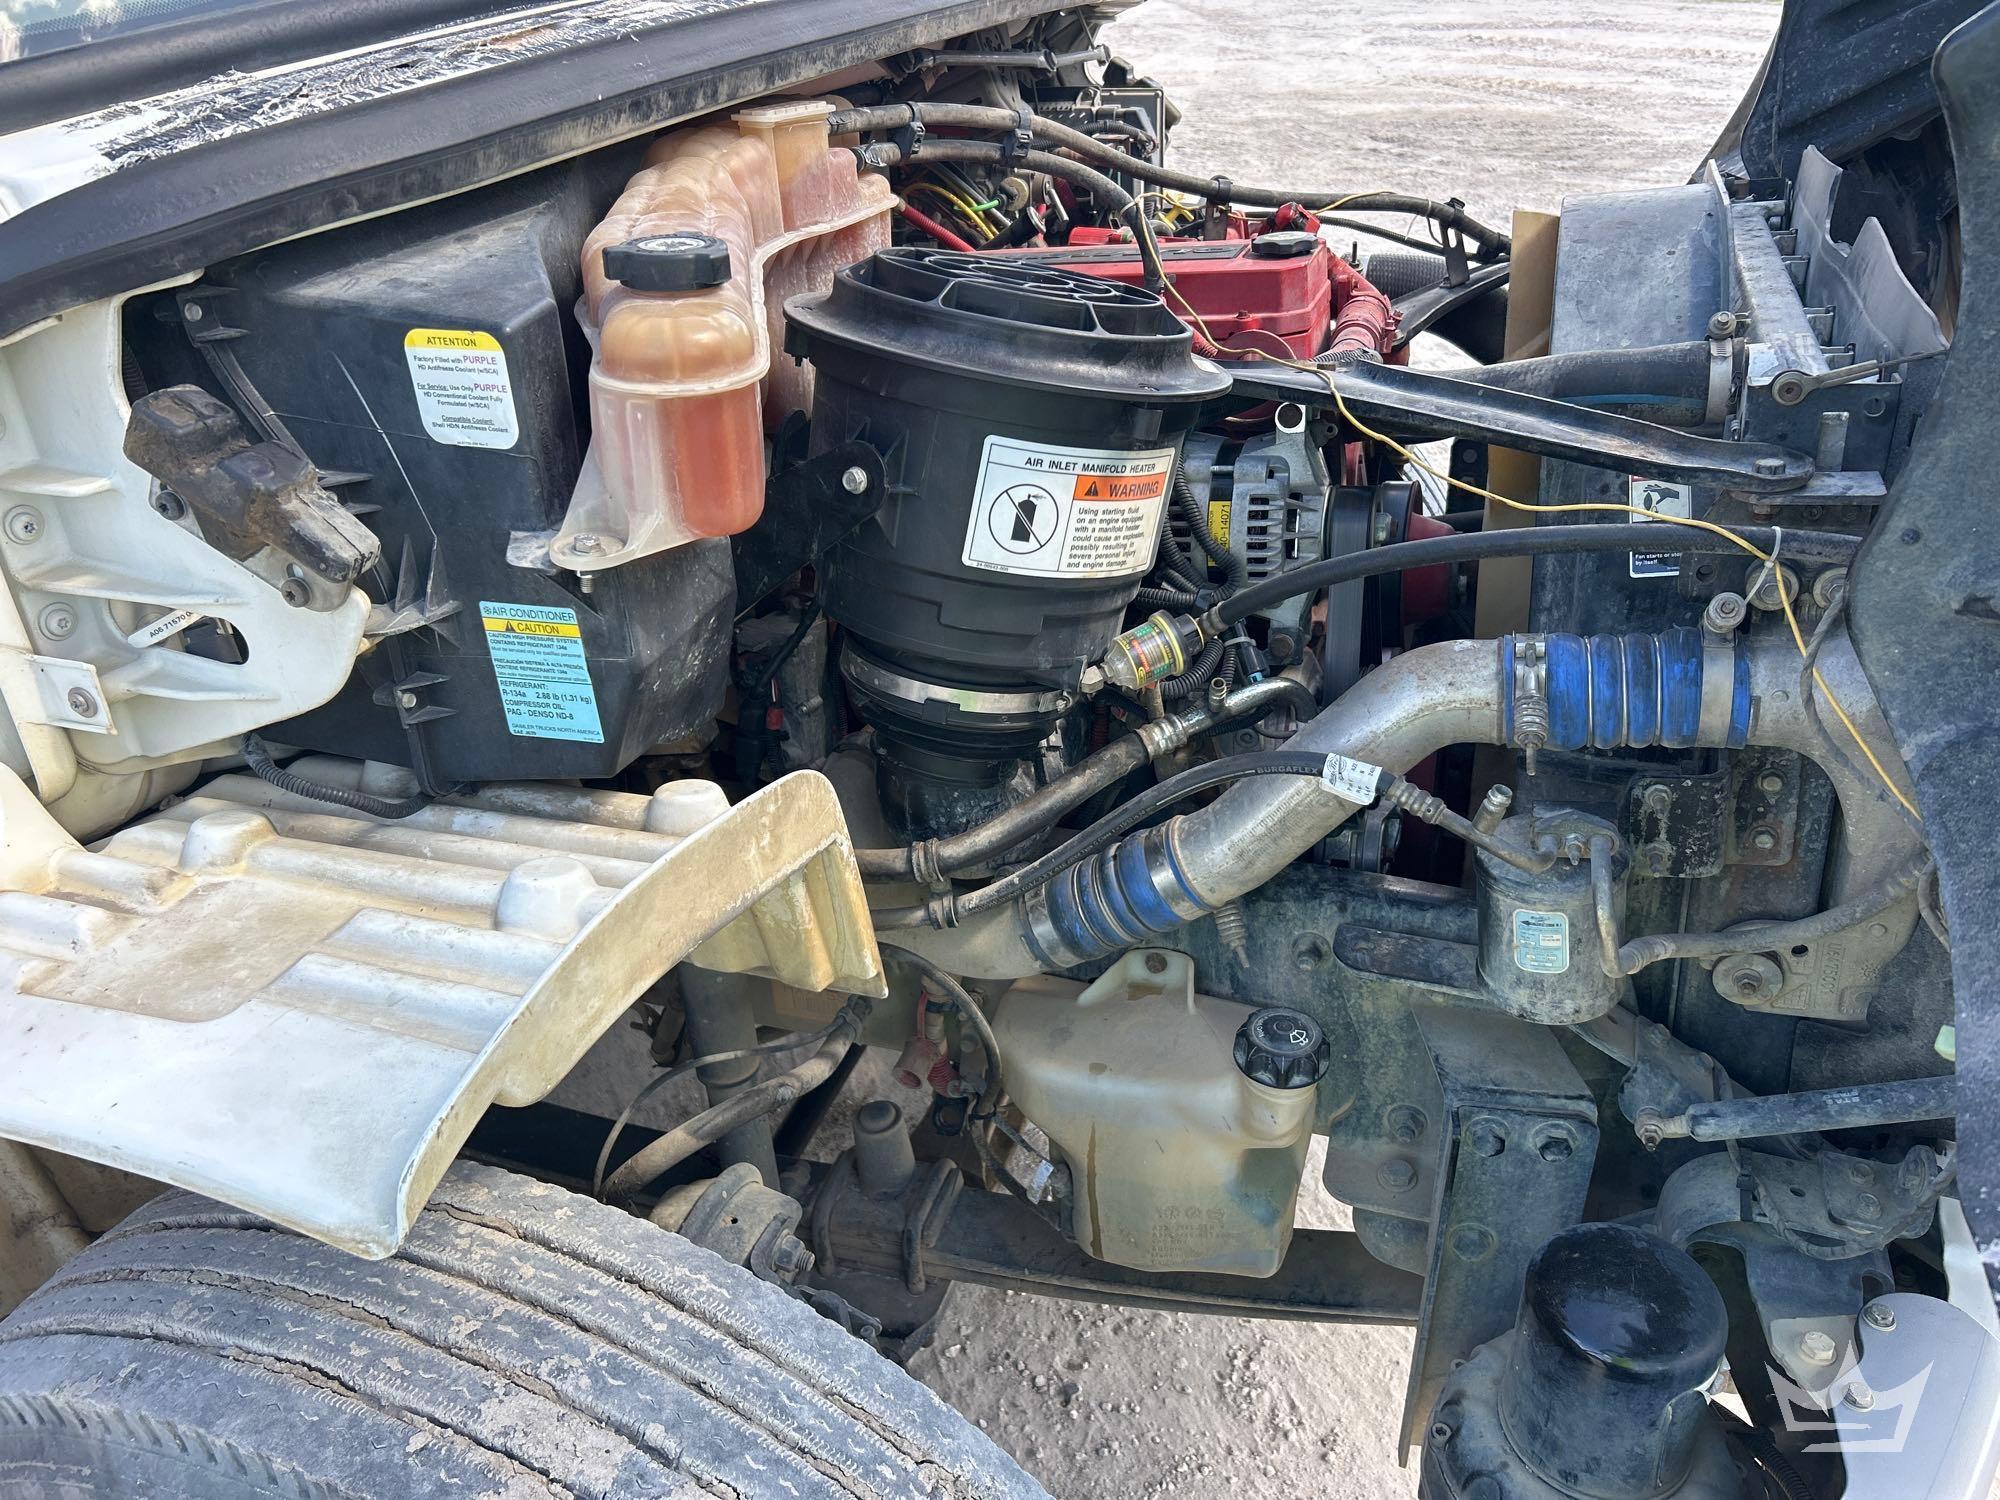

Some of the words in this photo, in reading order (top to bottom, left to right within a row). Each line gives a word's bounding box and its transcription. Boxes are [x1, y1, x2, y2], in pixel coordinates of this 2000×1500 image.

[427, 337, 476, 347] ATTENTION
[414, 355, 433, 364] Factory
[463, 356, 497, 365] PURPLE
[474, 383, 508, 393] PURPLE
[442, 415, 472, 423] Compatible
[1025, 457, 1043, 467] AIR
[1049, 460, 1078, 471] INLET
[1082, 463, 1127, 473] MANIFOLD
[1130, 464, 1156, 473] HEATER
[1109, 481, 1159, 497] WARNING
[1078, 507, 1098, 516] Using
[1099, 517, 1119, 525] engine
[1121, 514, 1144, 524] equipped
[1220, 504, 1230, 552] 40-14071
[1070, 544, 1099, 552] possibly
[1103, 542, 1127, 550] resulting
[1095, 551, 1120, 560] personal
[492, 607, 506, 616] AIR
[510, 609, 575, 621] CONDITIONER
[517, 623, 560, 634] CAUTION
[517, 641, 555, 649] REFRIGERANT
[500, 680, 549, 690] REFRIGERANT:
[503, 689, 526, 697] R-134a
[561, 694, 578, 702] (1.31
[580, 696, 592, 704] kg)
[505, 699, 551, 709] COMPRESSOR
[528, 710, 554, 718] DENSO
[556, 712, 574, 720] ND-8
